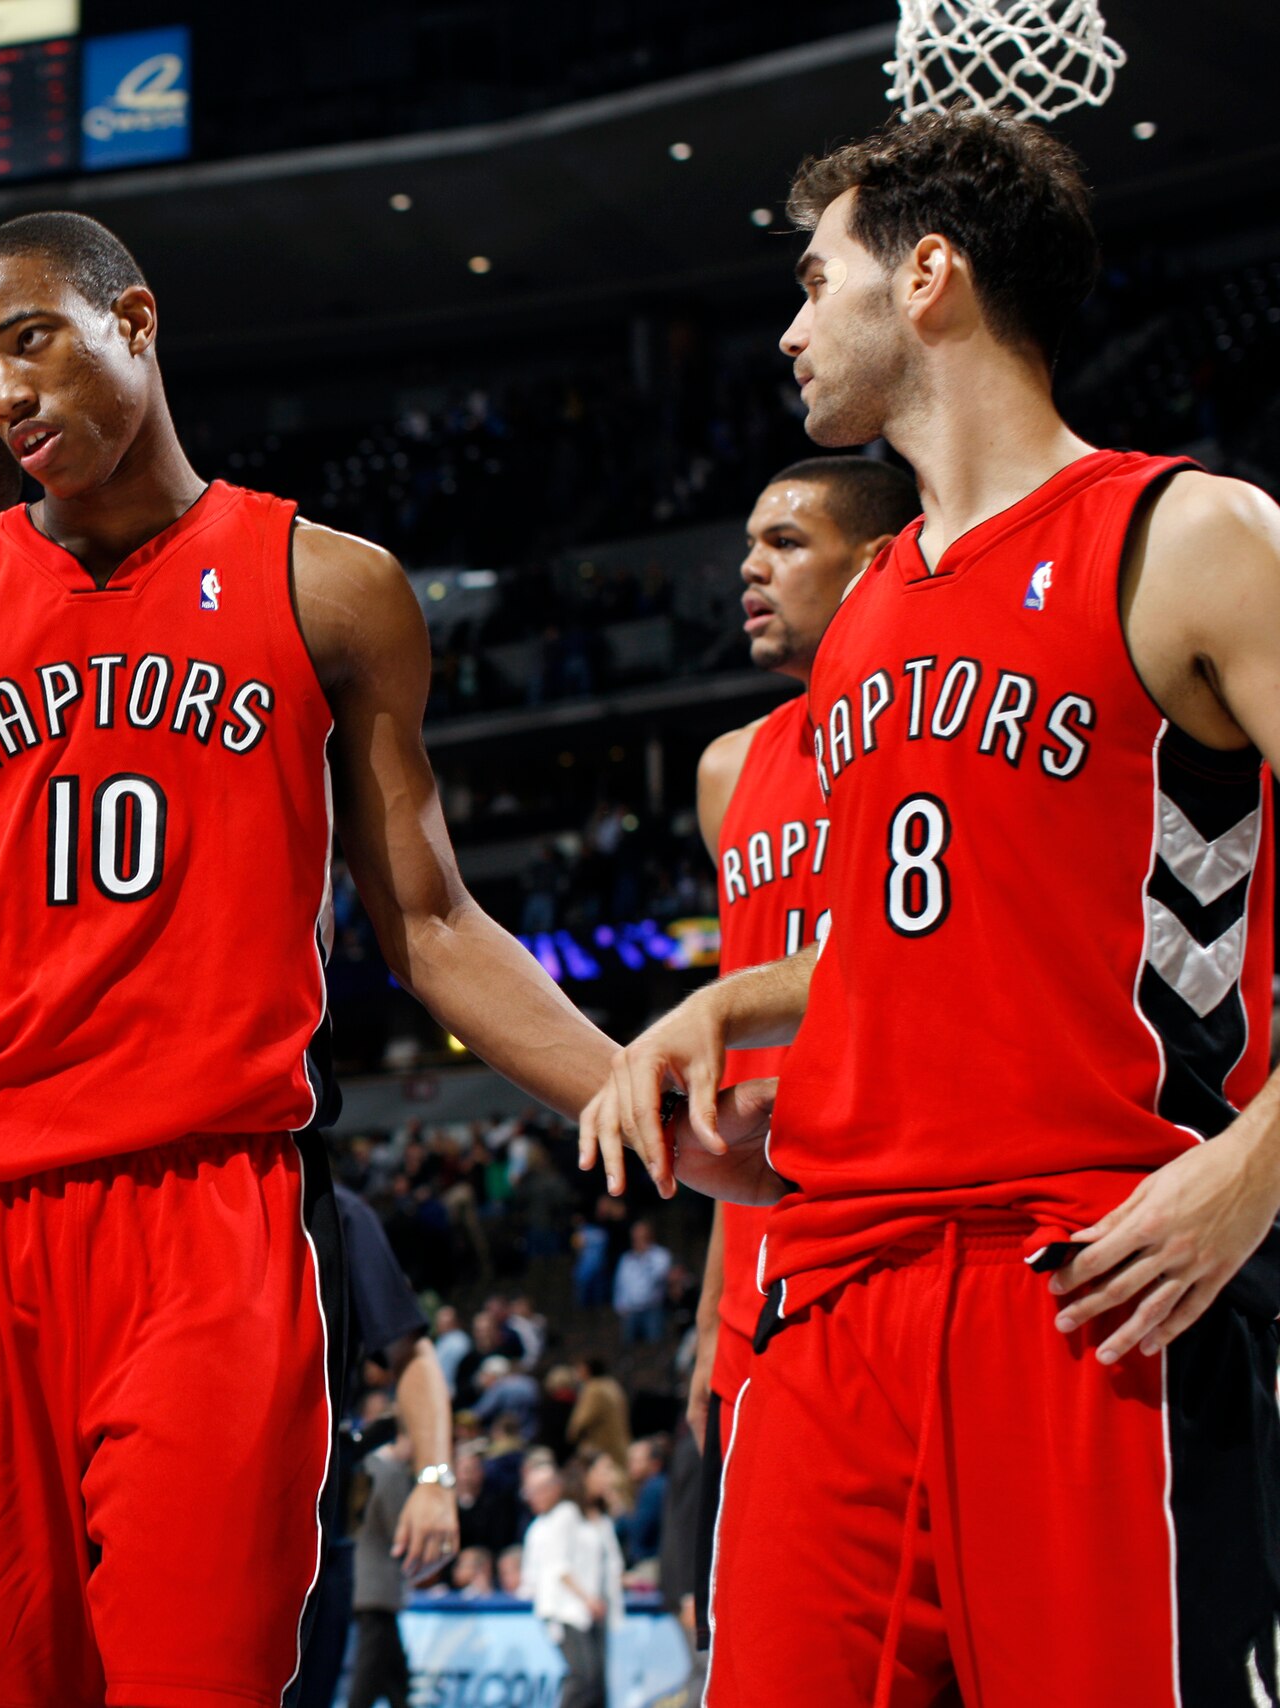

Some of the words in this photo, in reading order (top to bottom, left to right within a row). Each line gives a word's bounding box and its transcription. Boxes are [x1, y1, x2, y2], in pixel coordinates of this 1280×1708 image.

[814, 655, 1097, 804] RAPTORS
[47, 772, 168, 906] 10
[723, 818, 830, 904] RAPT
[884, 791, 951, 938] 8
